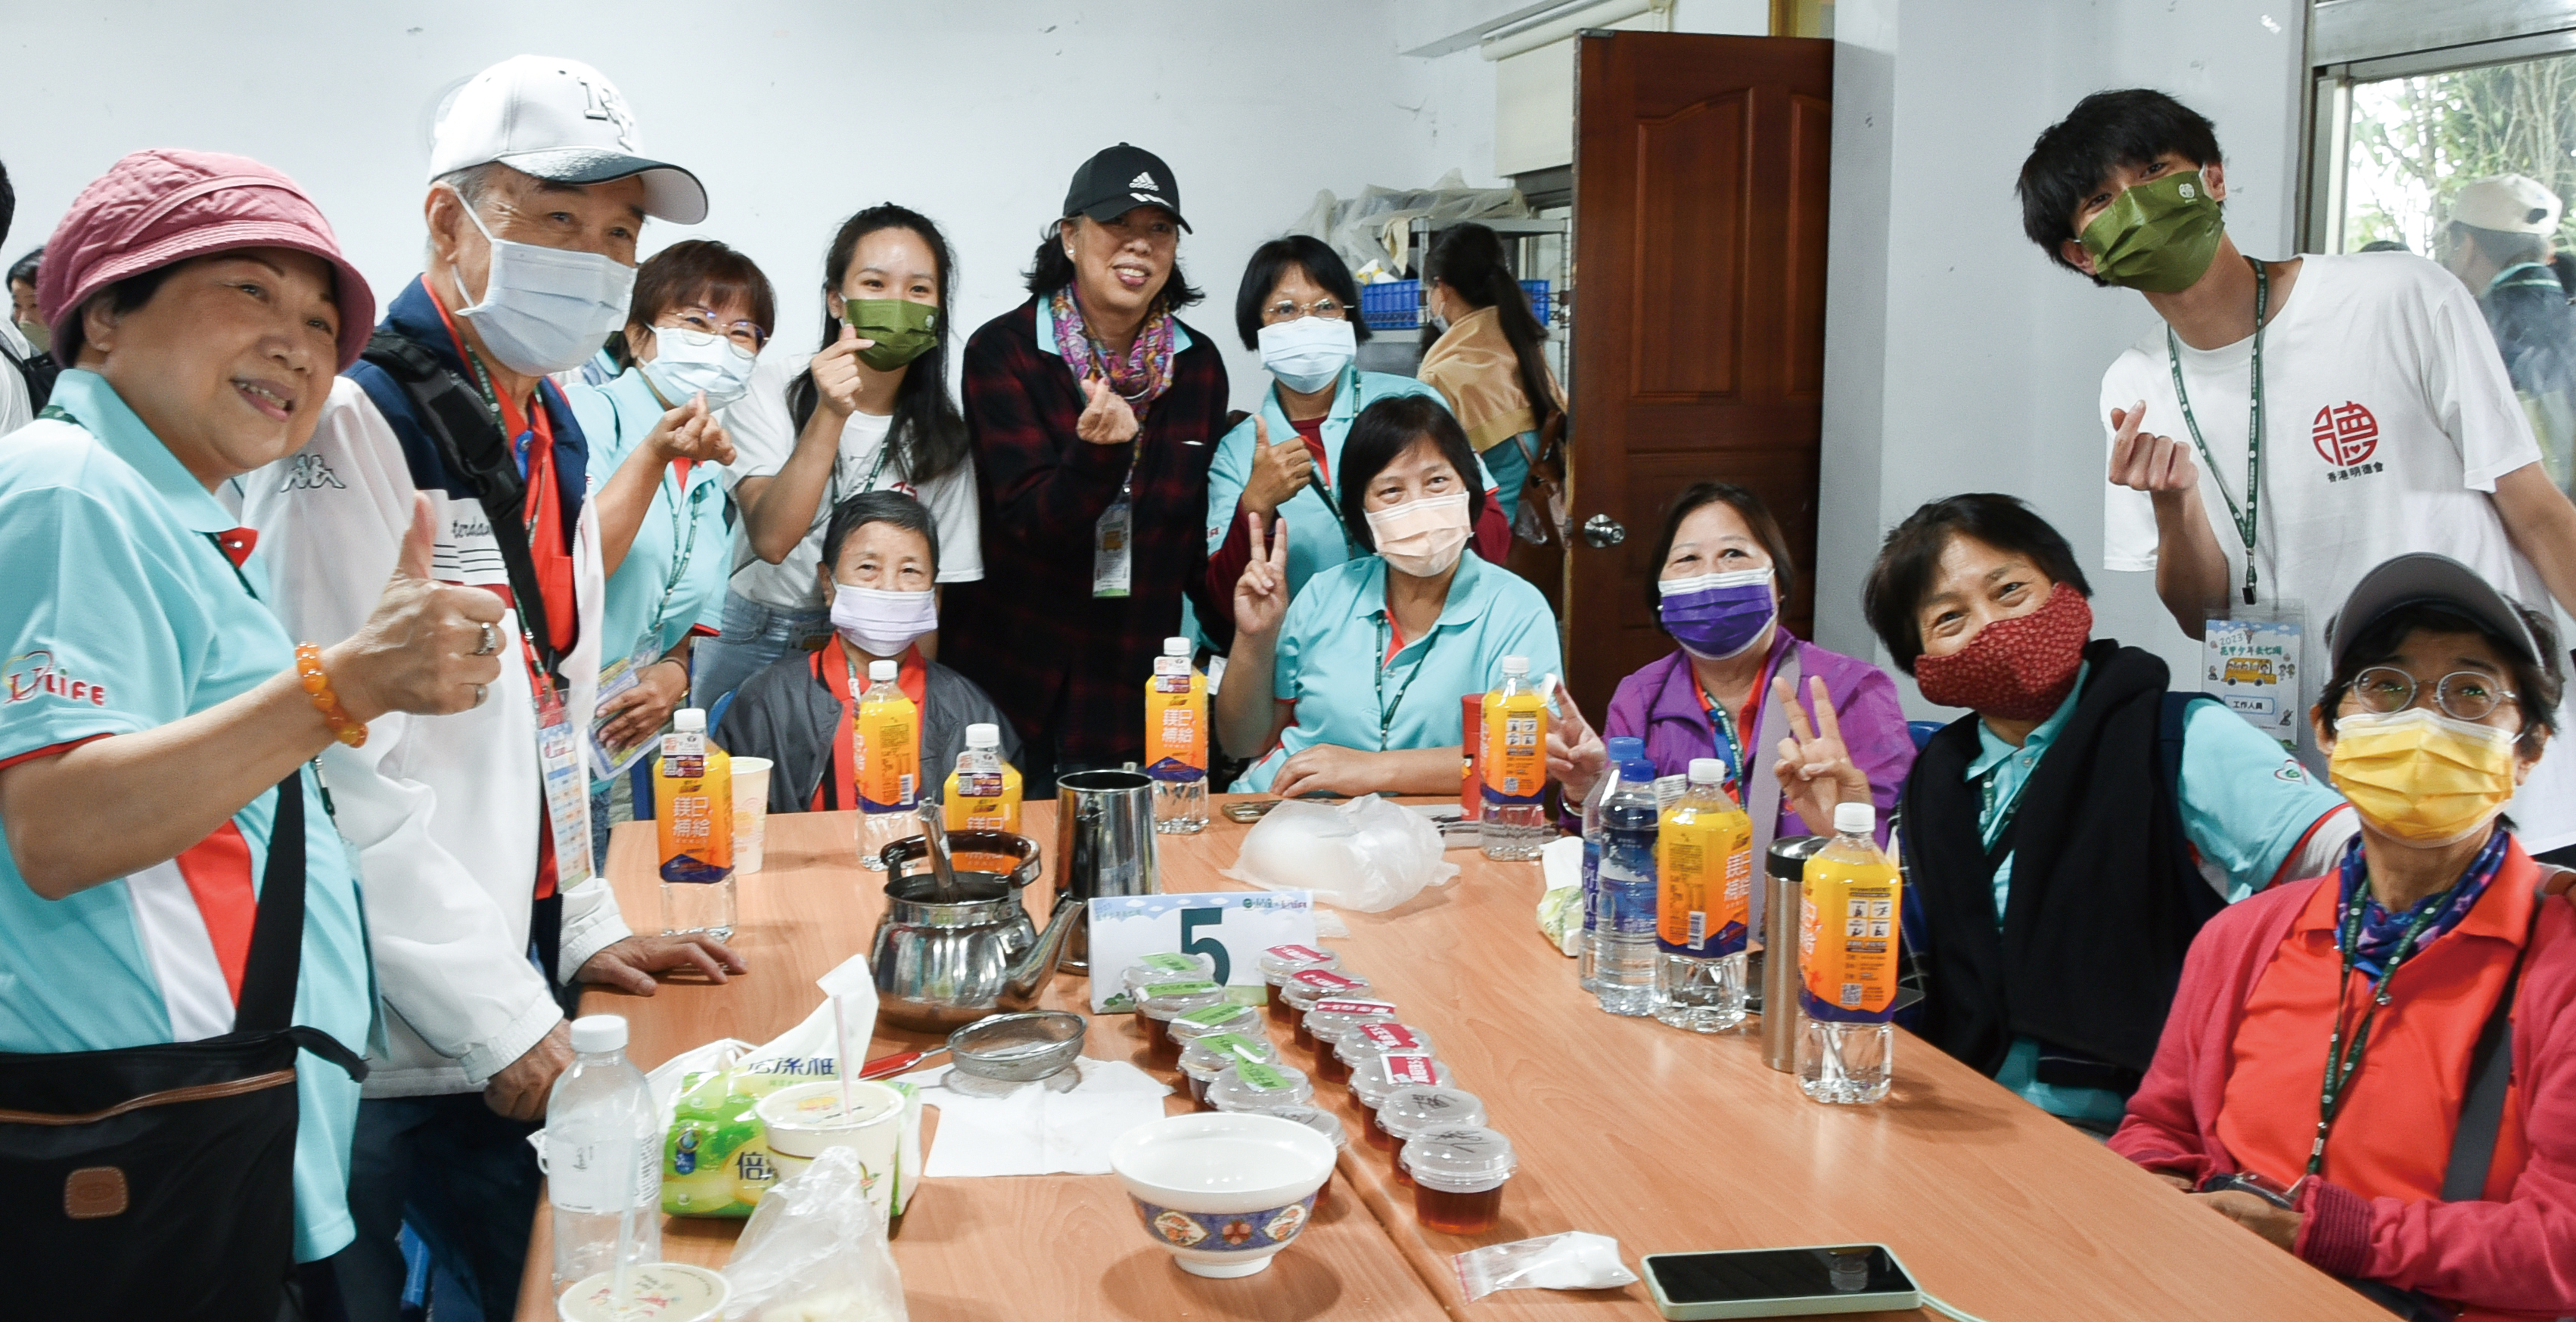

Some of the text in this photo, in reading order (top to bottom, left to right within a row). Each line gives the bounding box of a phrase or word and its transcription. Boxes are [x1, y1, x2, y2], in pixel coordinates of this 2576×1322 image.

[2327, 461, 2384, 483] 香港明德會
[2220, 633, 2244, 646] 2023
[2233, 700, 2264, 710] 工作人員
[1181, 907, 1230, 987] 5
